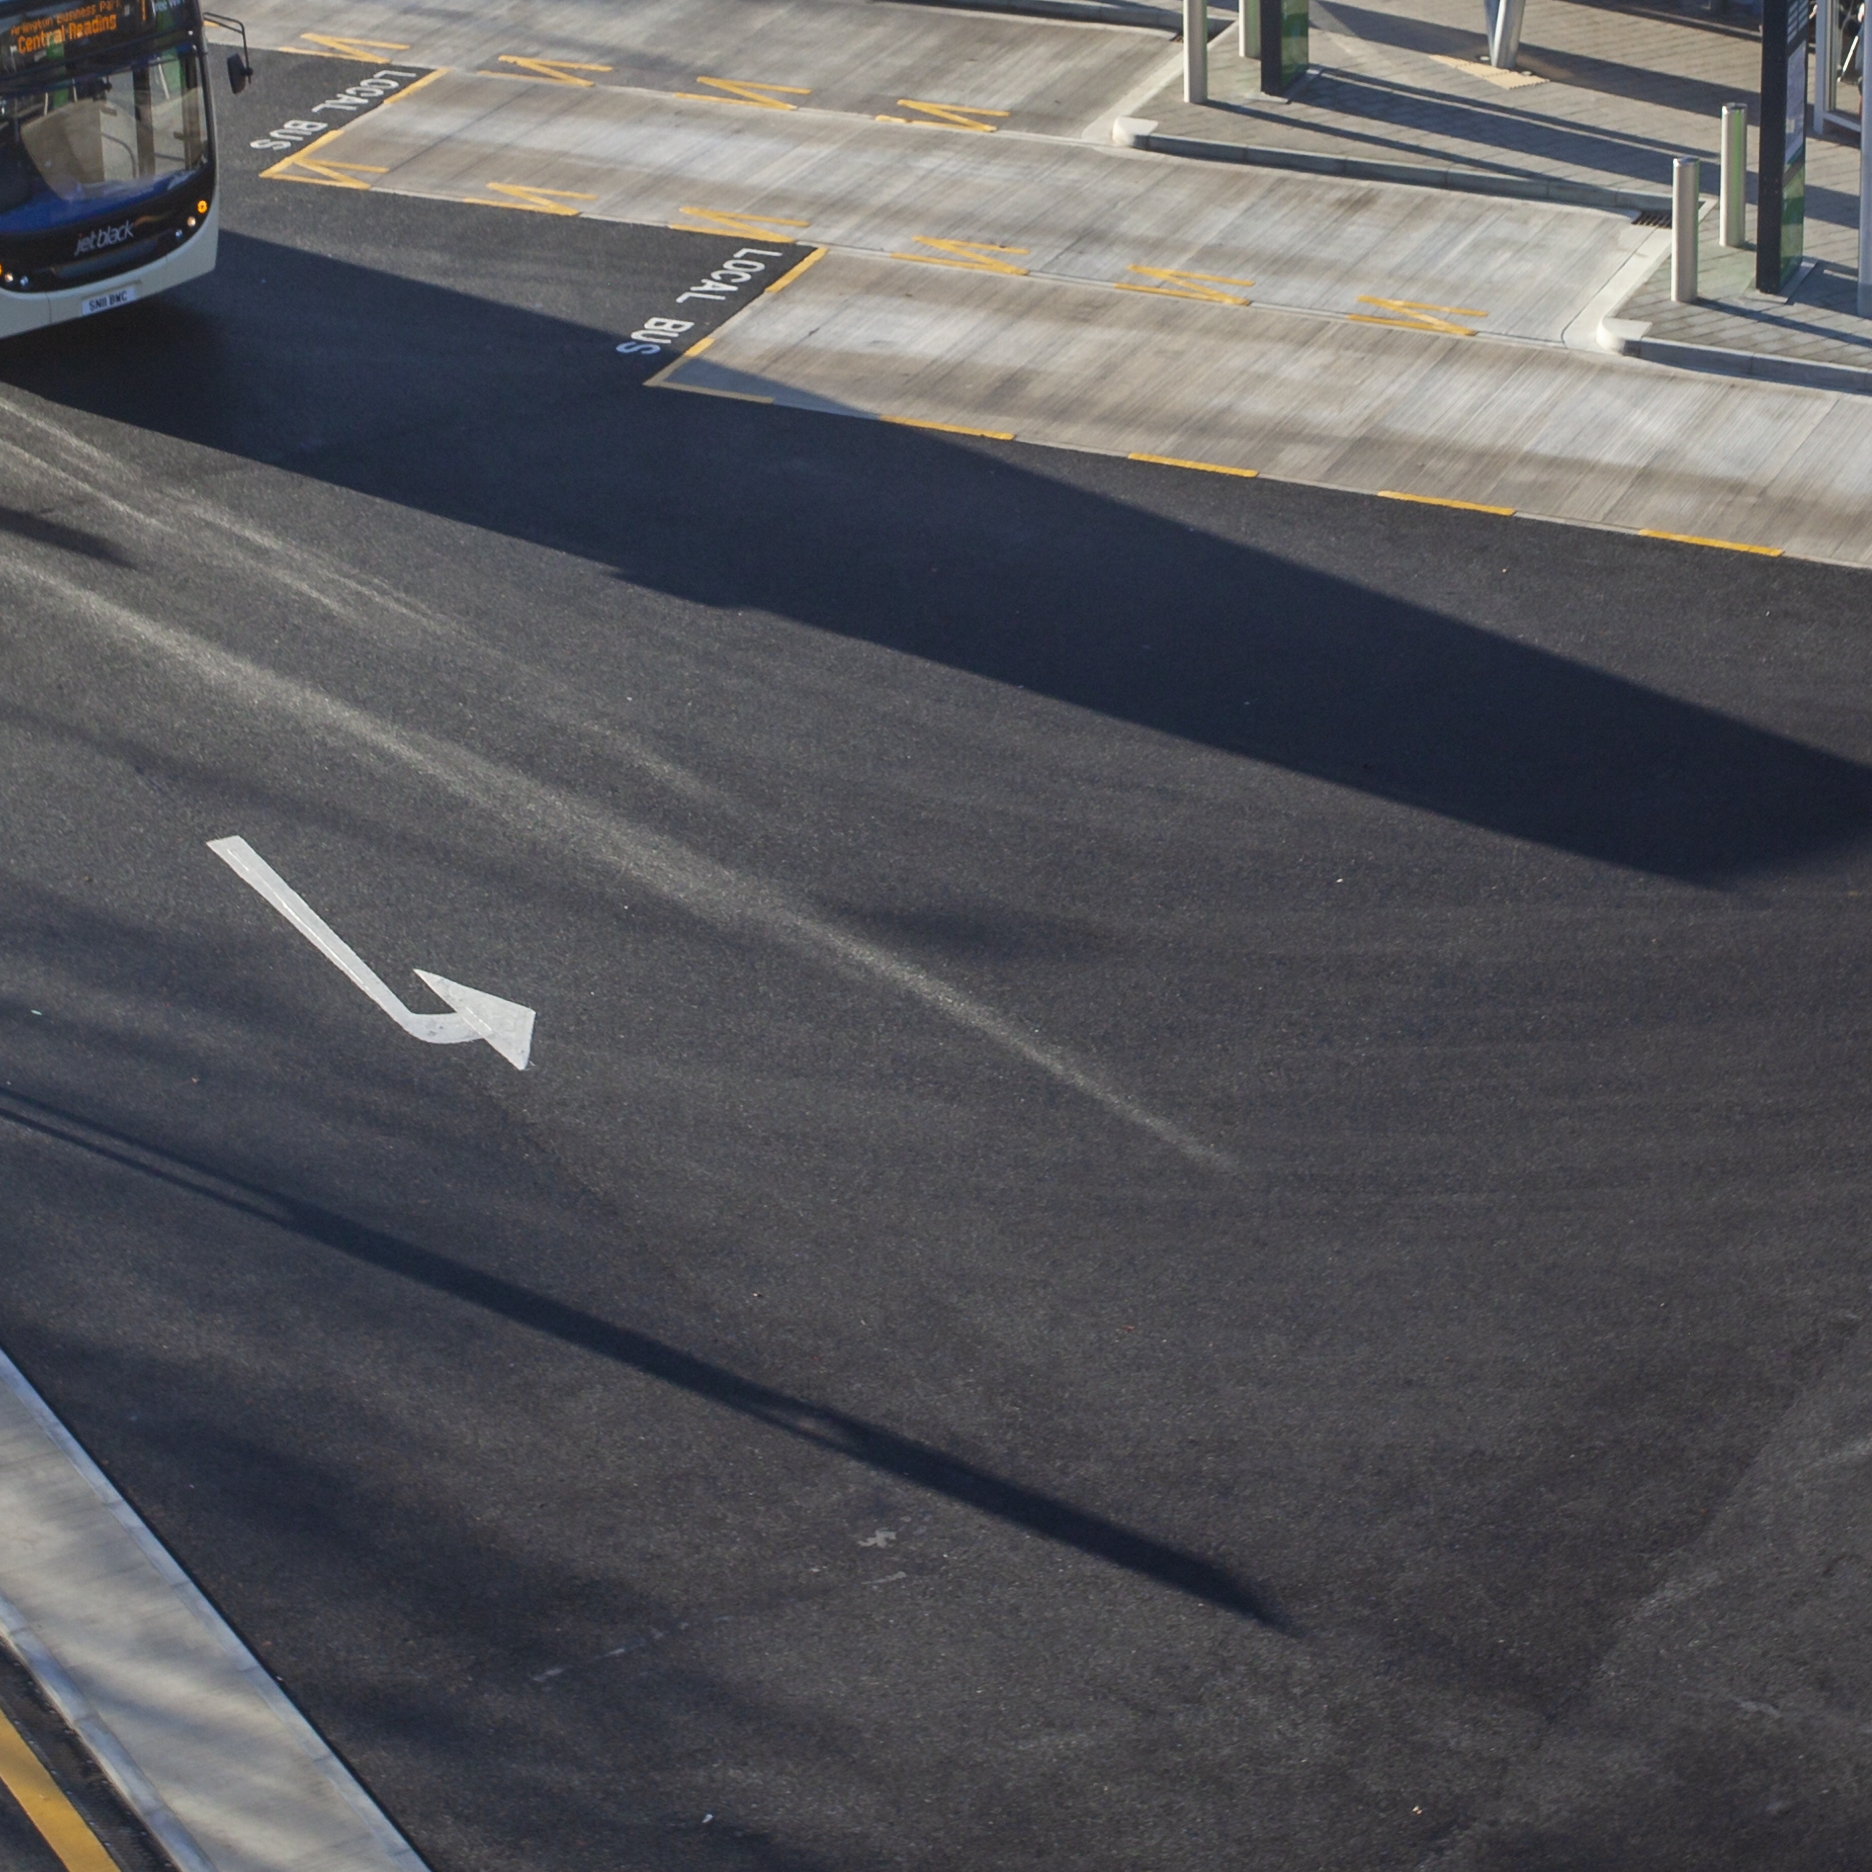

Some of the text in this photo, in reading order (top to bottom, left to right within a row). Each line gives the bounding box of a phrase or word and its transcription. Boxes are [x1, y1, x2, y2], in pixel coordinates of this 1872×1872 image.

[16, 13, 118, 55] Central Reading
[247, 66, 420, 154] LOCAL BUS
[615, 244, 784, 358] LOCAL BUS
